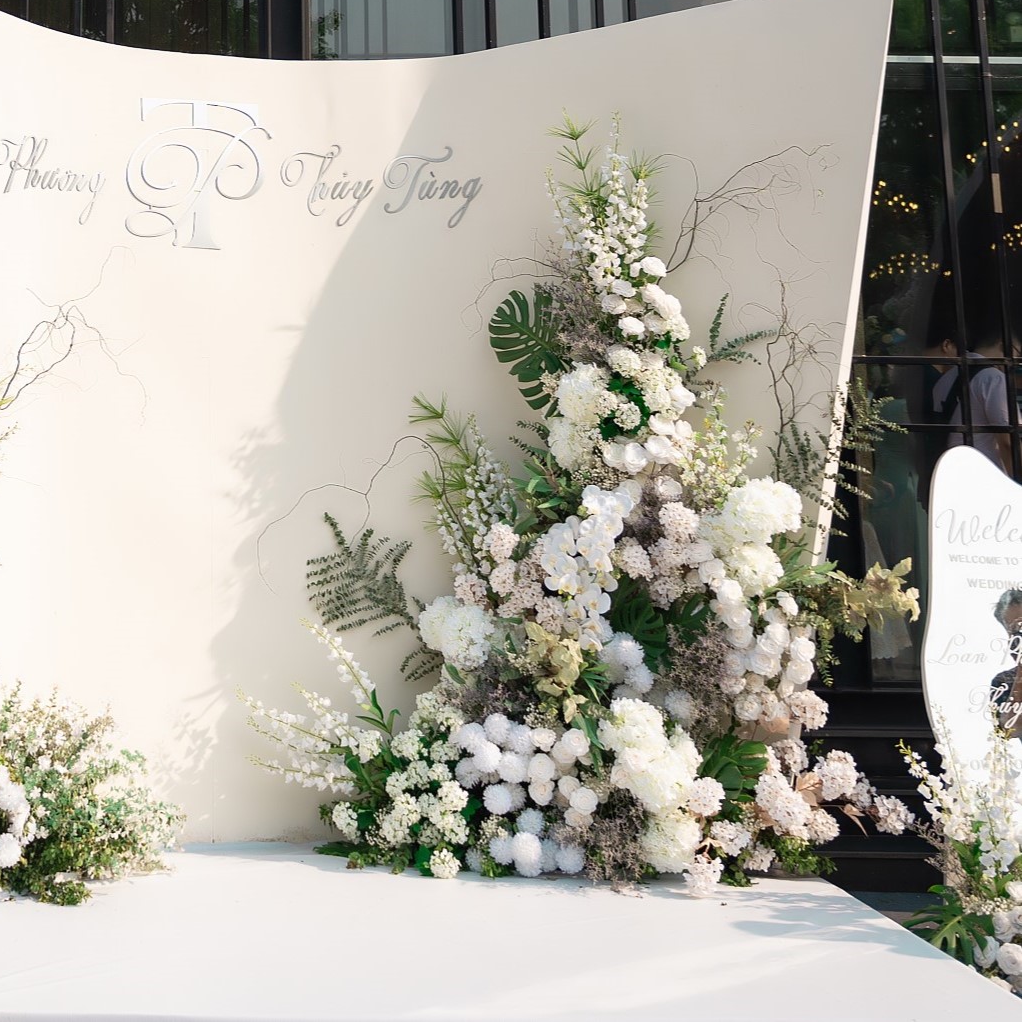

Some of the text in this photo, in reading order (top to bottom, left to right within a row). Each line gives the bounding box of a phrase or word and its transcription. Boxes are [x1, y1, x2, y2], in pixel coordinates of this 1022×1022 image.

[382, 145, 484, 229] Tùng
[935, 504, 1022, 546] Welc
[948, 553, 1002, 566] WELCOME
[1004, 556, 1019, 566] TO
[927, 634, 987, 665] Lan
